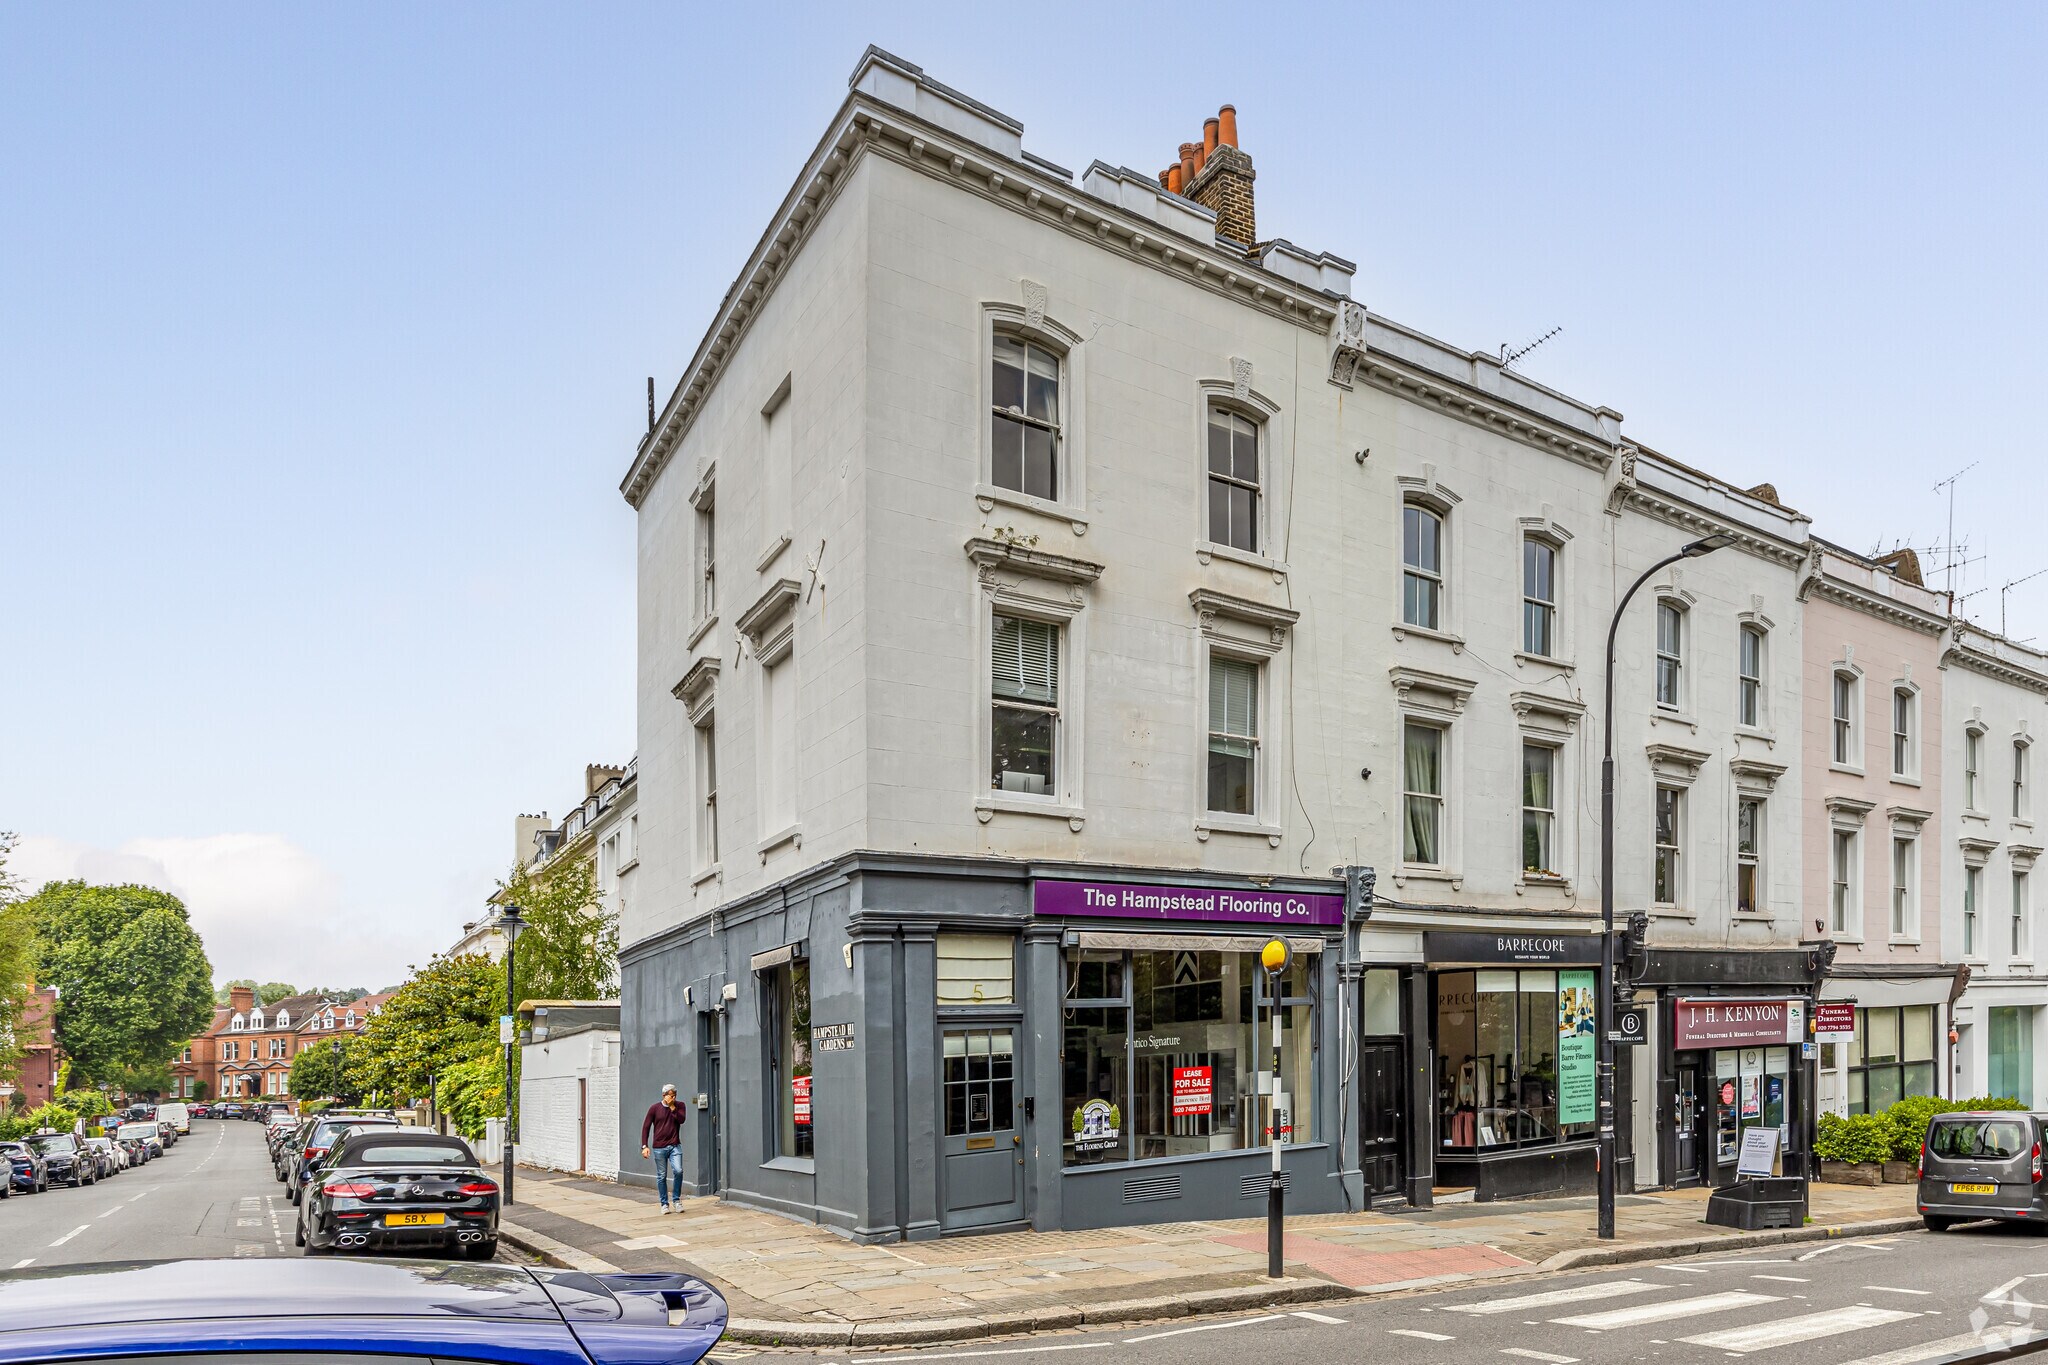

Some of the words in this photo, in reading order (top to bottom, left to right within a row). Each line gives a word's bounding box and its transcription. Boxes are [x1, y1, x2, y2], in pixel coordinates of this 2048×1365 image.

[1084, 888, 1116, 906] The
[1122, 890, 1215, 913] Hampstead
[1220, 896, 1282, 918] Flooring
[1286, 898, 1310, 916] Co.
[1497, 937, 1565, 952] BARRECORE
[973, 984, 984, 1003] 5
[1627, 1017, 1635, 1029] B
[1688, 1008, 1699, 1028] J.
[1706, 1007, 1720, 1023] H.
[820, 1038, 845, 1051] GARDENS
[1124, 1037, 1148, 1049] Atico
[1149, 1034, 1180, 1049] Signature
[1561, 1044, 1583, 1052] Boutique
[1561, 1063, 1577, 1071] Studio
[1175, 1080, 1190, 1088] FOR
[1192, 1078, 1210, 1087] SALE
